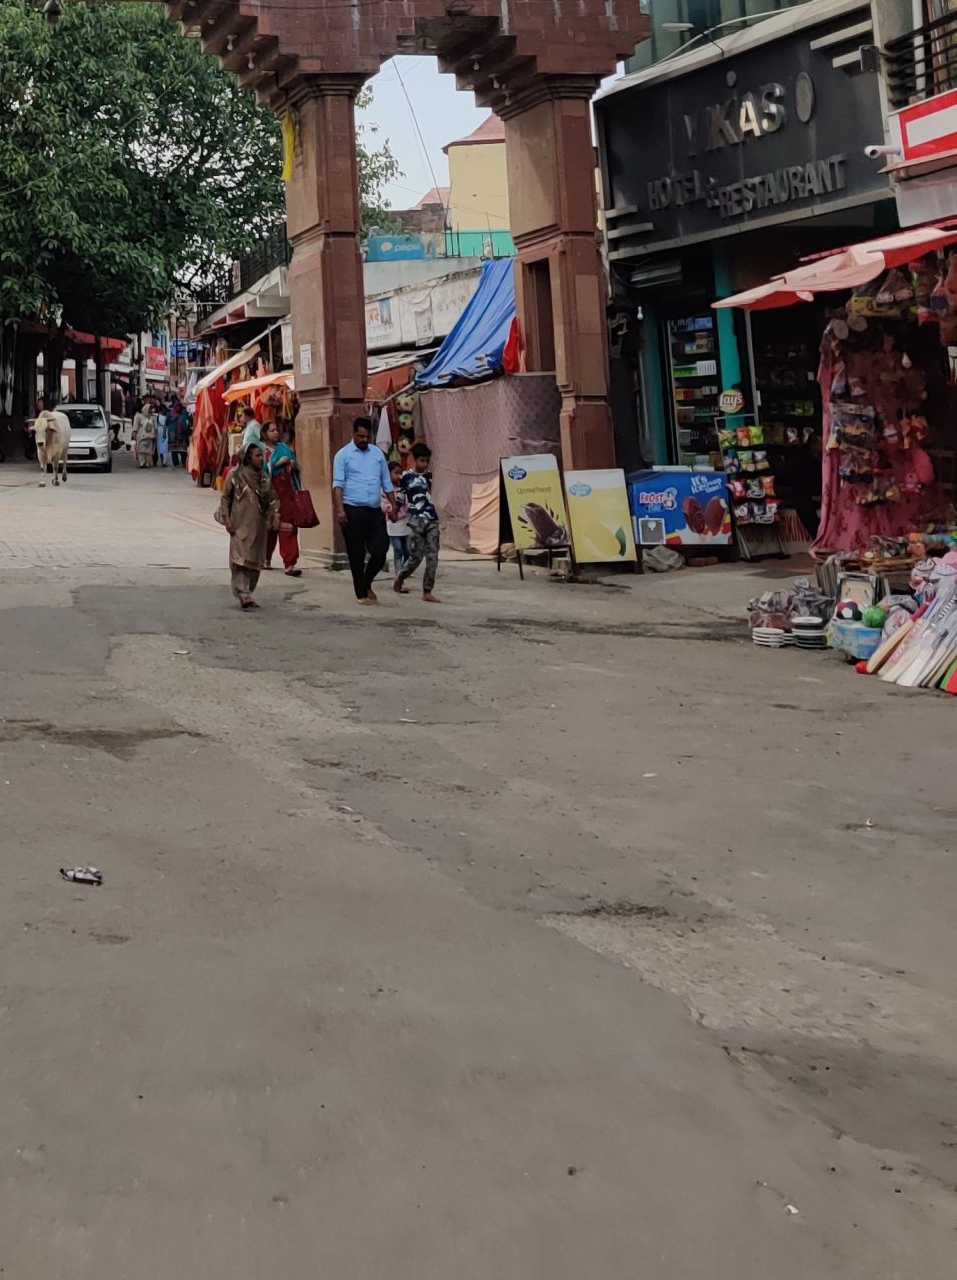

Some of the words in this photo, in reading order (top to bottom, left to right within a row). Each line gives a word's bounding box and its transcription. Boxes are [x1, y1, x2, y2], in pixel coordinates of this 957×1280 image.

[647, 169, 705, 211] HOTEL
[718, 153, 847, 218] RESTAURANT
[719, 389, 744, 408] Lay's
[640, 492, 664, 504] FROST
